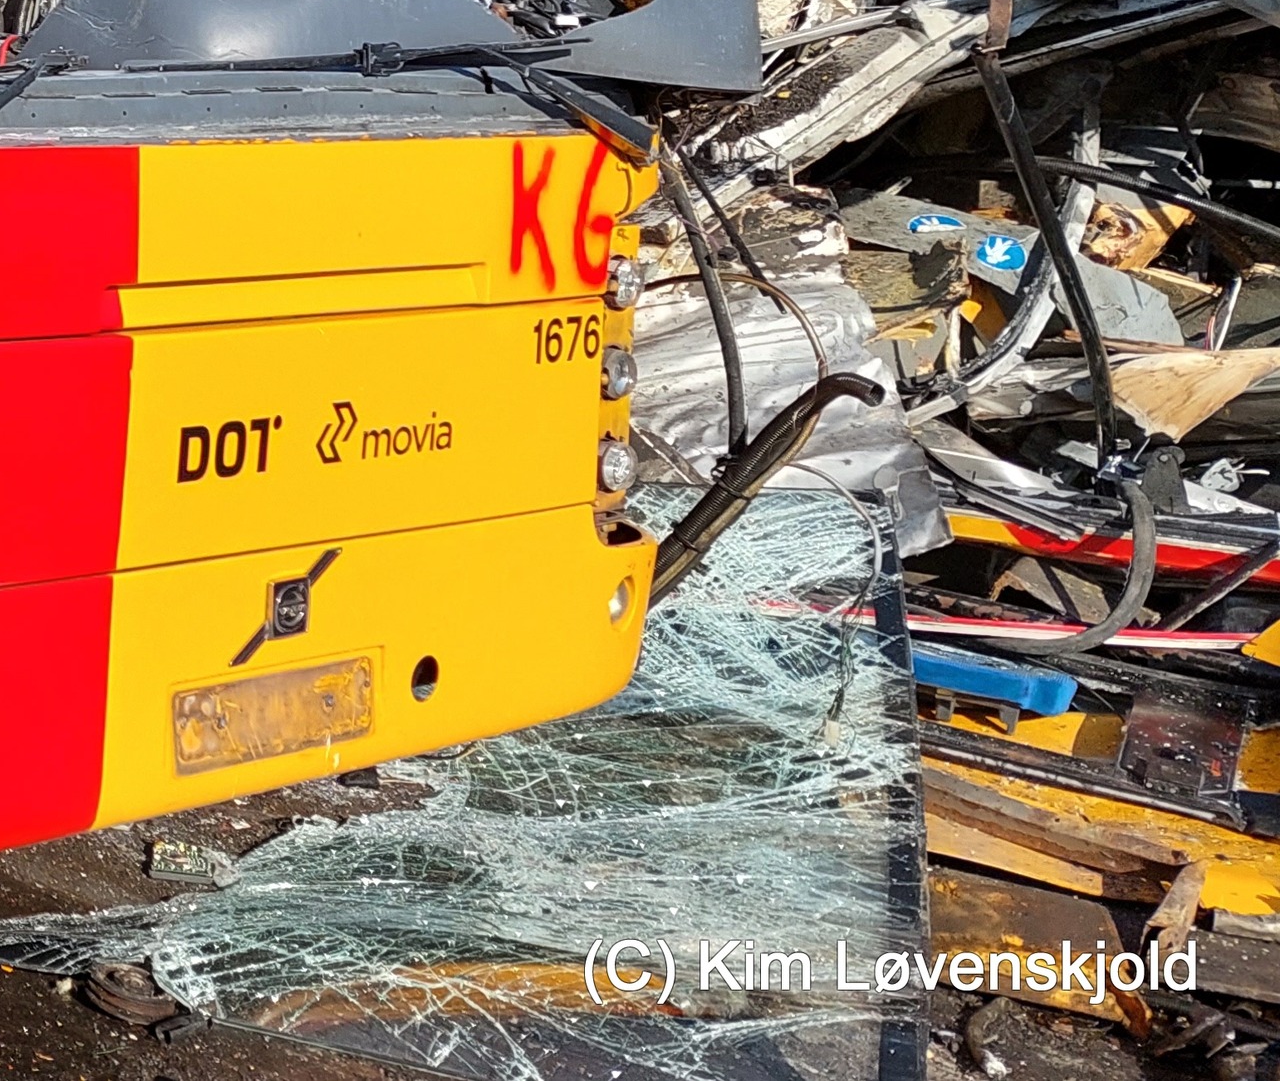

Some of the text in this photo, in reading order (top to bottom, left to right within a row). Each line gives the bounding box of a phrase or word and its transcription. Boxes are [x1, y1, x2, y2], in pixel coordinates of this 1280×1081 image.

[534, 314, 601, 364] 1676
[177, 415, 282, 483] DOT
[362, 412, 452, 459] movia
